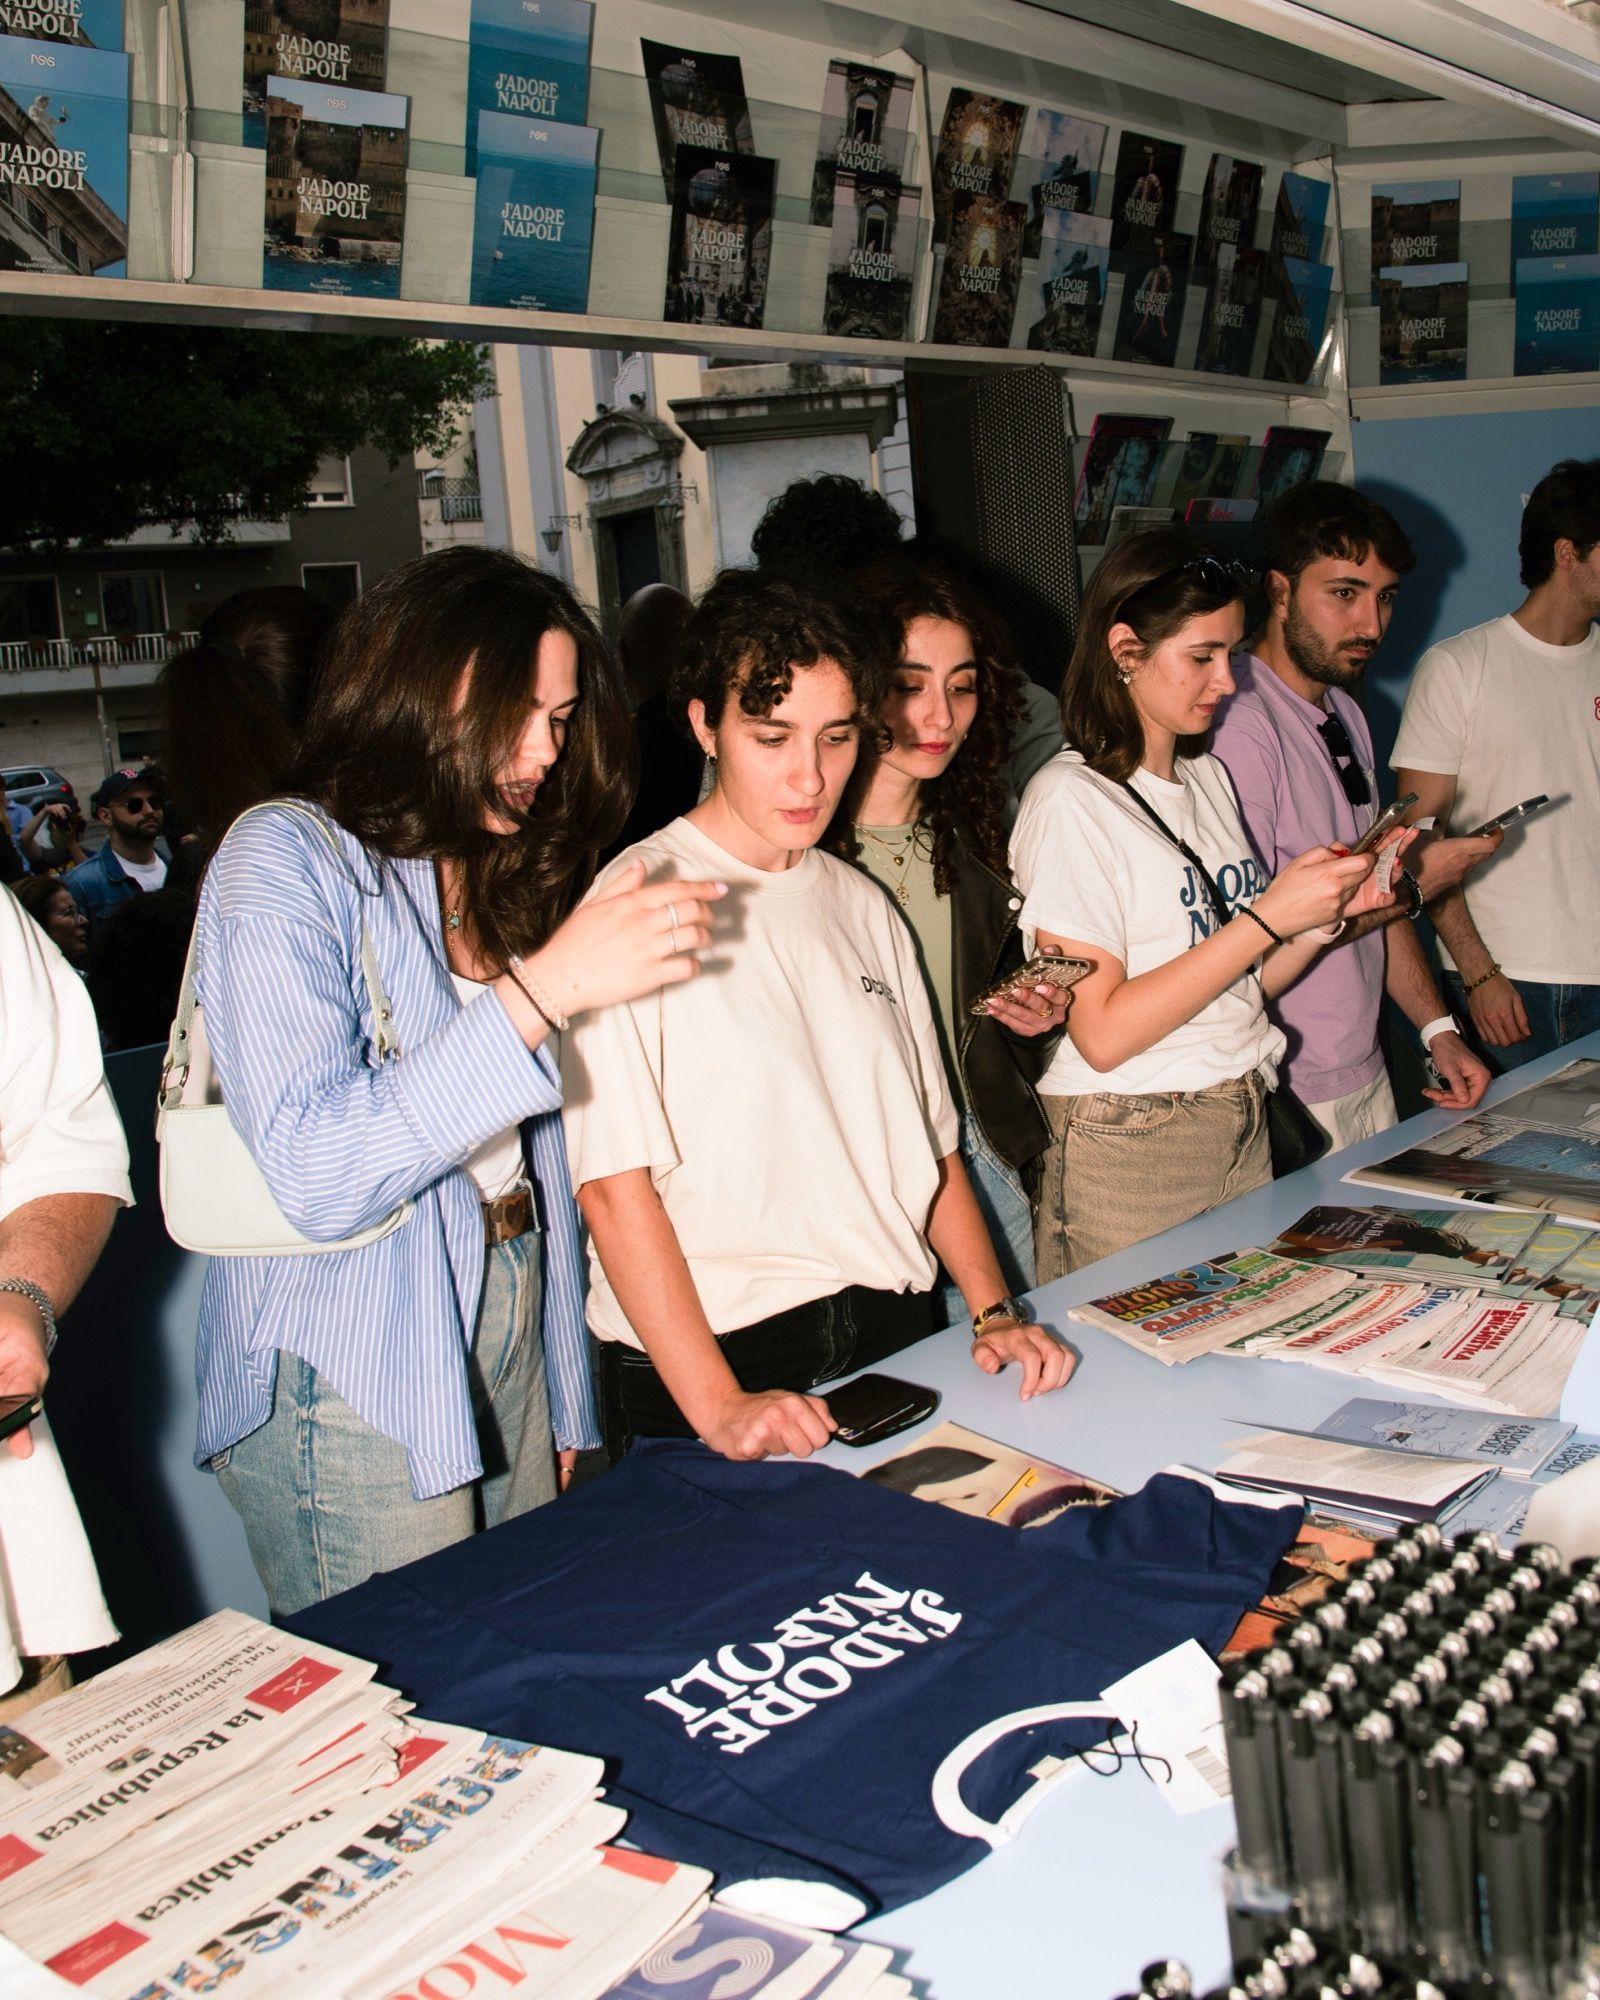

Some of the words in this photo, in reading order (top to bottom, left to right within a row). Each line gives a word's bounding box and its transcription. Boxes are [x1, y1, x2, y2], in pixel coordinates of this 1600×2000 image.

[0, 7, 80, 38] NAPOLI
[276, 34, 352, 63] J'ADORE
[279, 53, 349, 81] NAPOLI
[495, 73, 560, 99] J'ADORE
[498, 91, 556, 116] NAPOLI
[674, 115, 728, 139] J'ADORE
[0, 142, 88, 171] J'ADORE
[836, 138, 884, 160] J'ADORE
[836, 153, 880, 173] NAPOLI
[951, 161, 992, 182] J'ADORE
[0, 163, 85, 190] NAPOLI
[951, 175, 989, 194] NAPOLI
[297, 177, 371, 202] J'ADORE
[1041, 179, 1079, 198] J'ADORE
[300, 196, 368, 219] NAPOLI
[1040, 192, 1076, 211] NAPOLI
[1125, 197, 1160, 215] J'ADORE
[501, 202, 565, 225] J'ADORE
[1124, 208, 1157, 226] NAPOLI
[1211, 215, 1241, 232] J'ADORE
[503, 220, 562, 241] NAPOLI
[690, 227, 745, 249] J'ADORE
[1210, 226, 1240, 242] NAPOLI
[1530, 227, 1578, 241] J'ADORE
[1390, 235, 1438, 250] J'ADORE
[1392, 246, 1436, 259] NAPOLI
[1532, 237, 1576, 250] NAPOLI
[691, 244, 742, 263] NAPOLI
[849, 249, 895, 268] J'ADORE
[849, 264, 892, 282] NAPOLI
[960, 264, 1001, 281] J'ADORE
[959, 278, 999, 294] NAPOLI
[1052, 276, 1089, 293] J'ADORE
[1052, 289, 1087, 305] NAPOLI
[1134, 289, 1170, 305] J'ADORE
[1134, 301, 1166, 317] NAPOLI
[1215, 302, 1245, 317] J'ADORE
[1534, 308, 1581, 322] J'ADORE
[1215, 313, 1244, 329] NAPOLI
[1400, 317, 1446, 330] J'ADORE
[1536, 320, 1579, 332] NAPOLI
[1401, 328, 1445, 340] NAPOLI
[1095, 1281, 1197, 1314] QUOTA
[1117, 1301, 1171, 1321] ALTA
[1140, 1301, 1234, 1333] LOTTO
[1324, 1318, 1409, 1355] CRUCIVERBA
[1452, 1309, 1515, 1361] ENIGMISTICA
[1483, 1308, 1526, 1351] SETTIMANA
[1476, 1423, 1519, 1455] NAPOLI
[1492, 1424, 1537, 1456] J'ADORE
[1543, 1442, 1587, 1474] NAPOLI
[237, 1642, 280, 1669] Toti,
[645, 1571, 911, 1723] NAPOLI
[685, 1588, 963, 1754] J'ADORE
[181, 1665, 245, 1704] Schlein
[125, 1699, 183, 1735] attacca
[225, 1708, 265, 1731] la
[65, 1729, 127, 1768] Meloni
[35, 1729, 232, 1843] Repubblica
